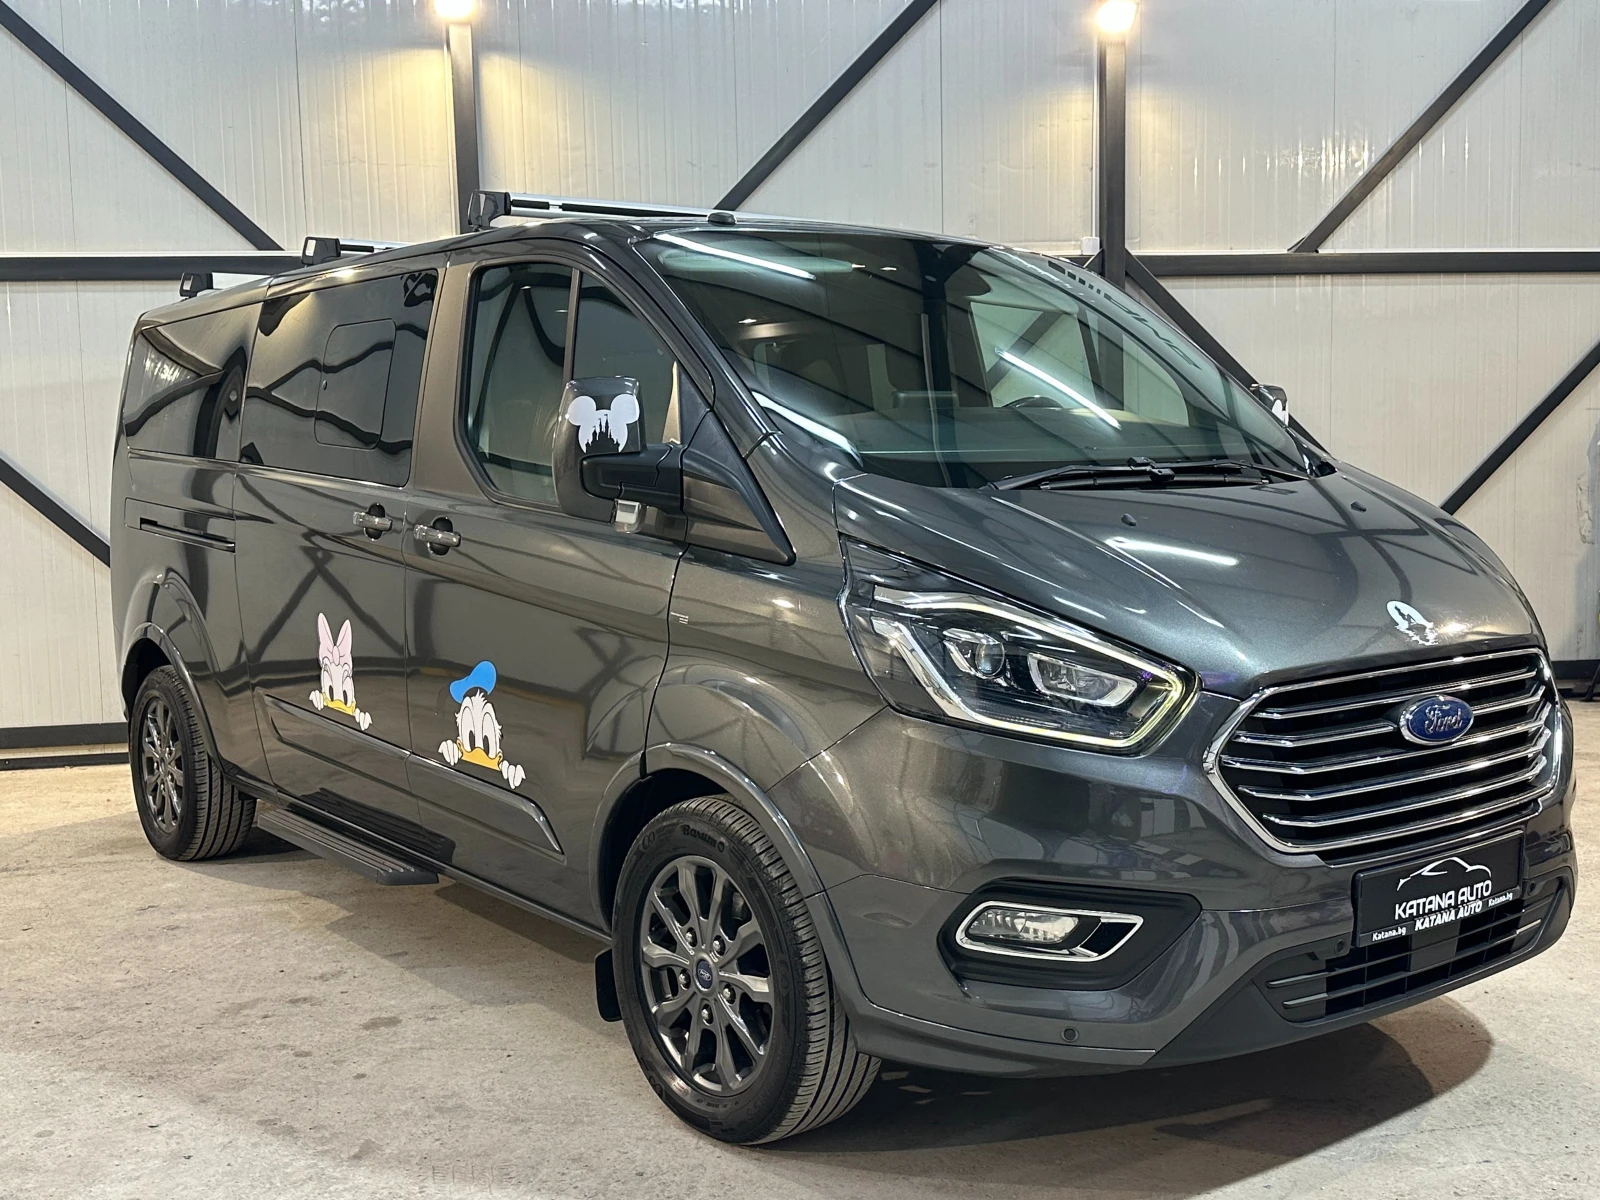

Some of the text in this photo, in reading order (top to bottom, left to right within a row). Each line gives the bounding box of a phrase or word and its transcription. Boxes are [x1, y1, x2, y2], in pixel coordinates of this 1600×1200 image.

[1425, 704, 1463, 734] Ford
[1395, 880, 1492, 920] KATANA AUTO
[1372, 927, 1407, 941] Katana.bg
[1415, 909, 1455, 931] KATANA
[1457, 901, 1482, 919] AUTO
